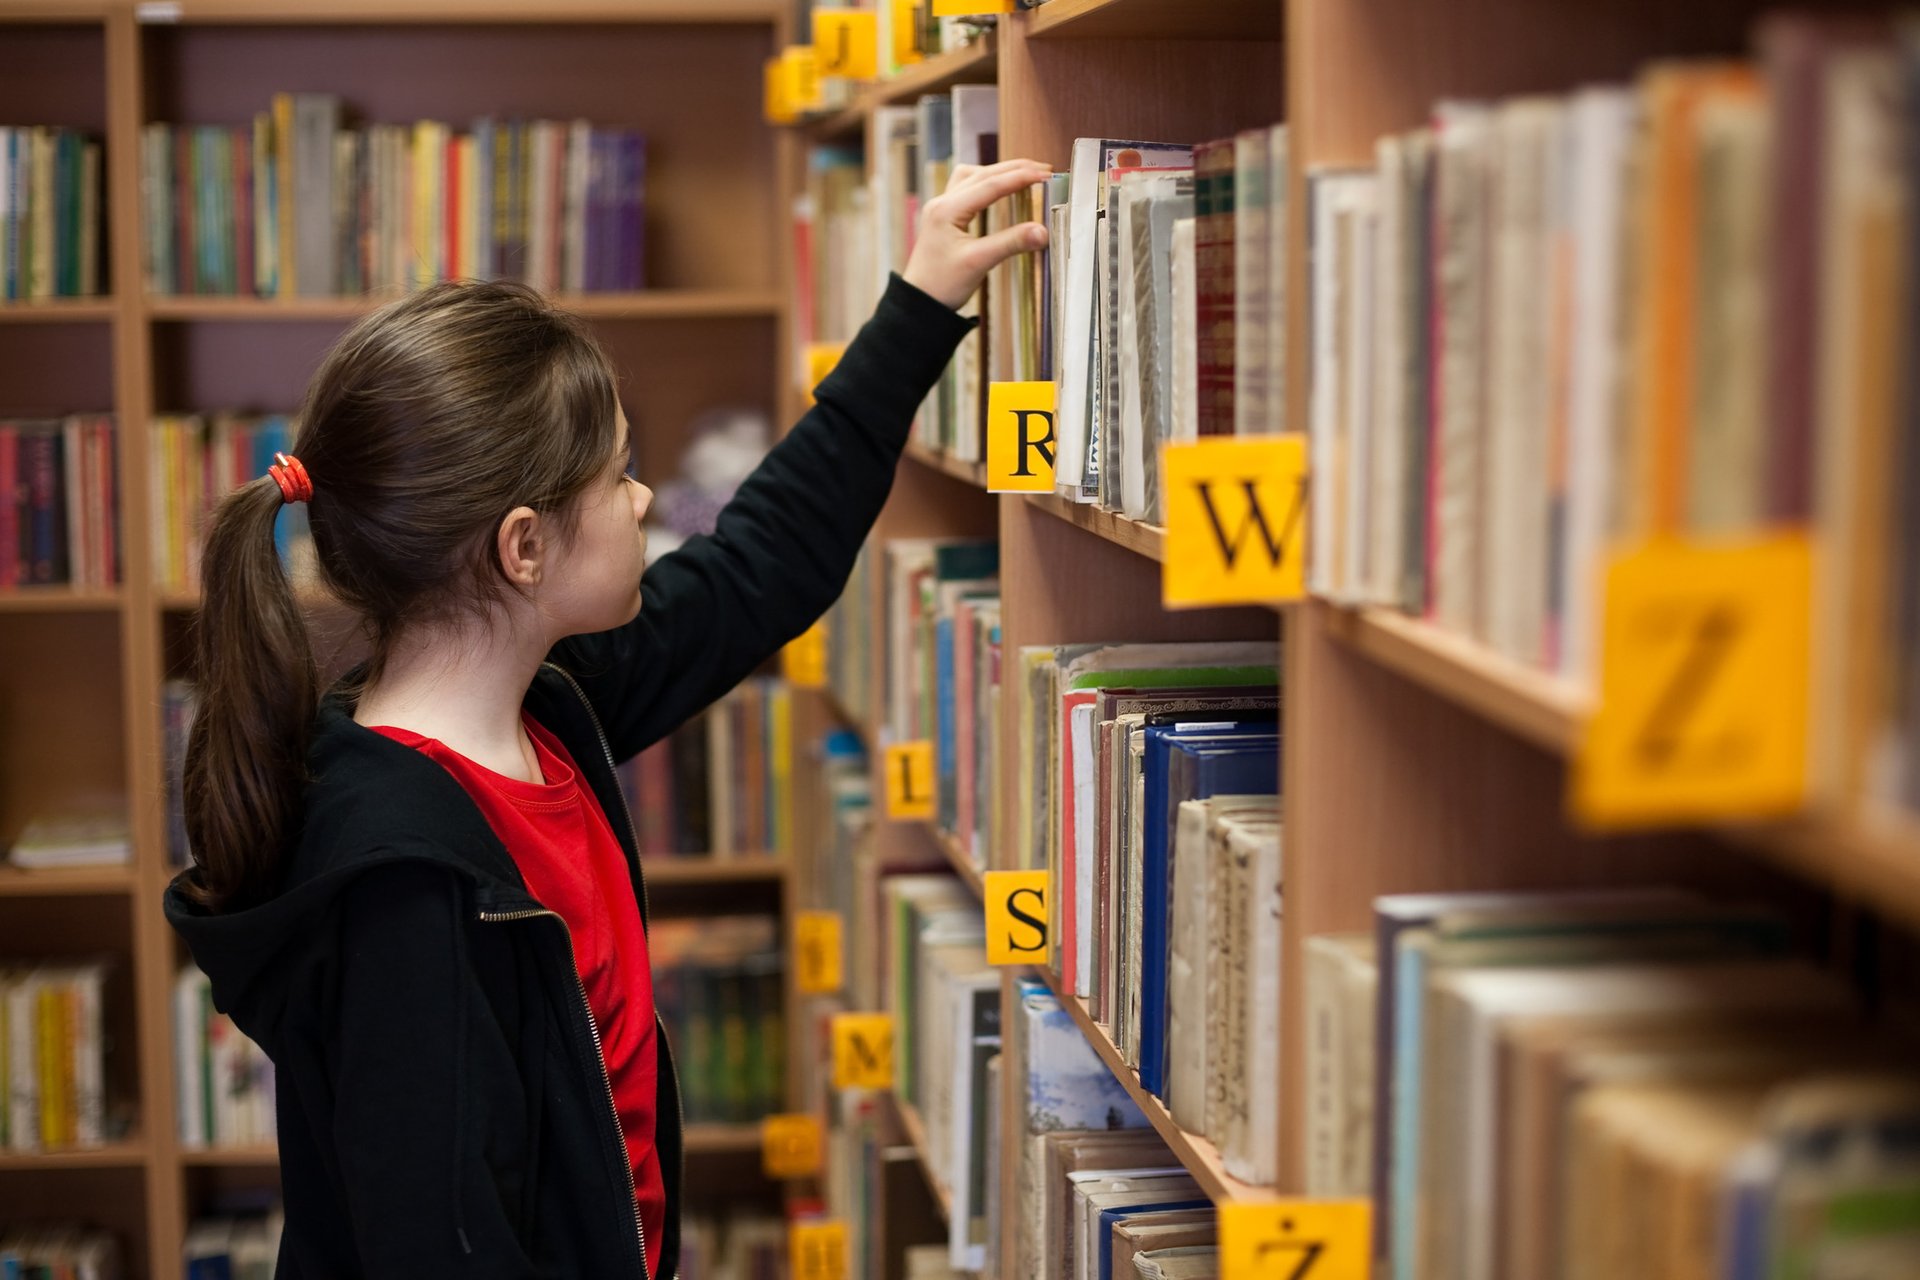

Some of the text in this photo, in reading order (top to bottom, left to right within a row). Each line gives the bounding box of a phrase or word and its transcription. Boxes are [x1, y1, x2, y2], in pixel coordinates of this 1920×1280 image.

[1008, 410, 1055, 476] R
[1188, 476, 1309, 569] W
[1626, 596, 1760, 778] Z
[1006, 888, 1047, 952] S
